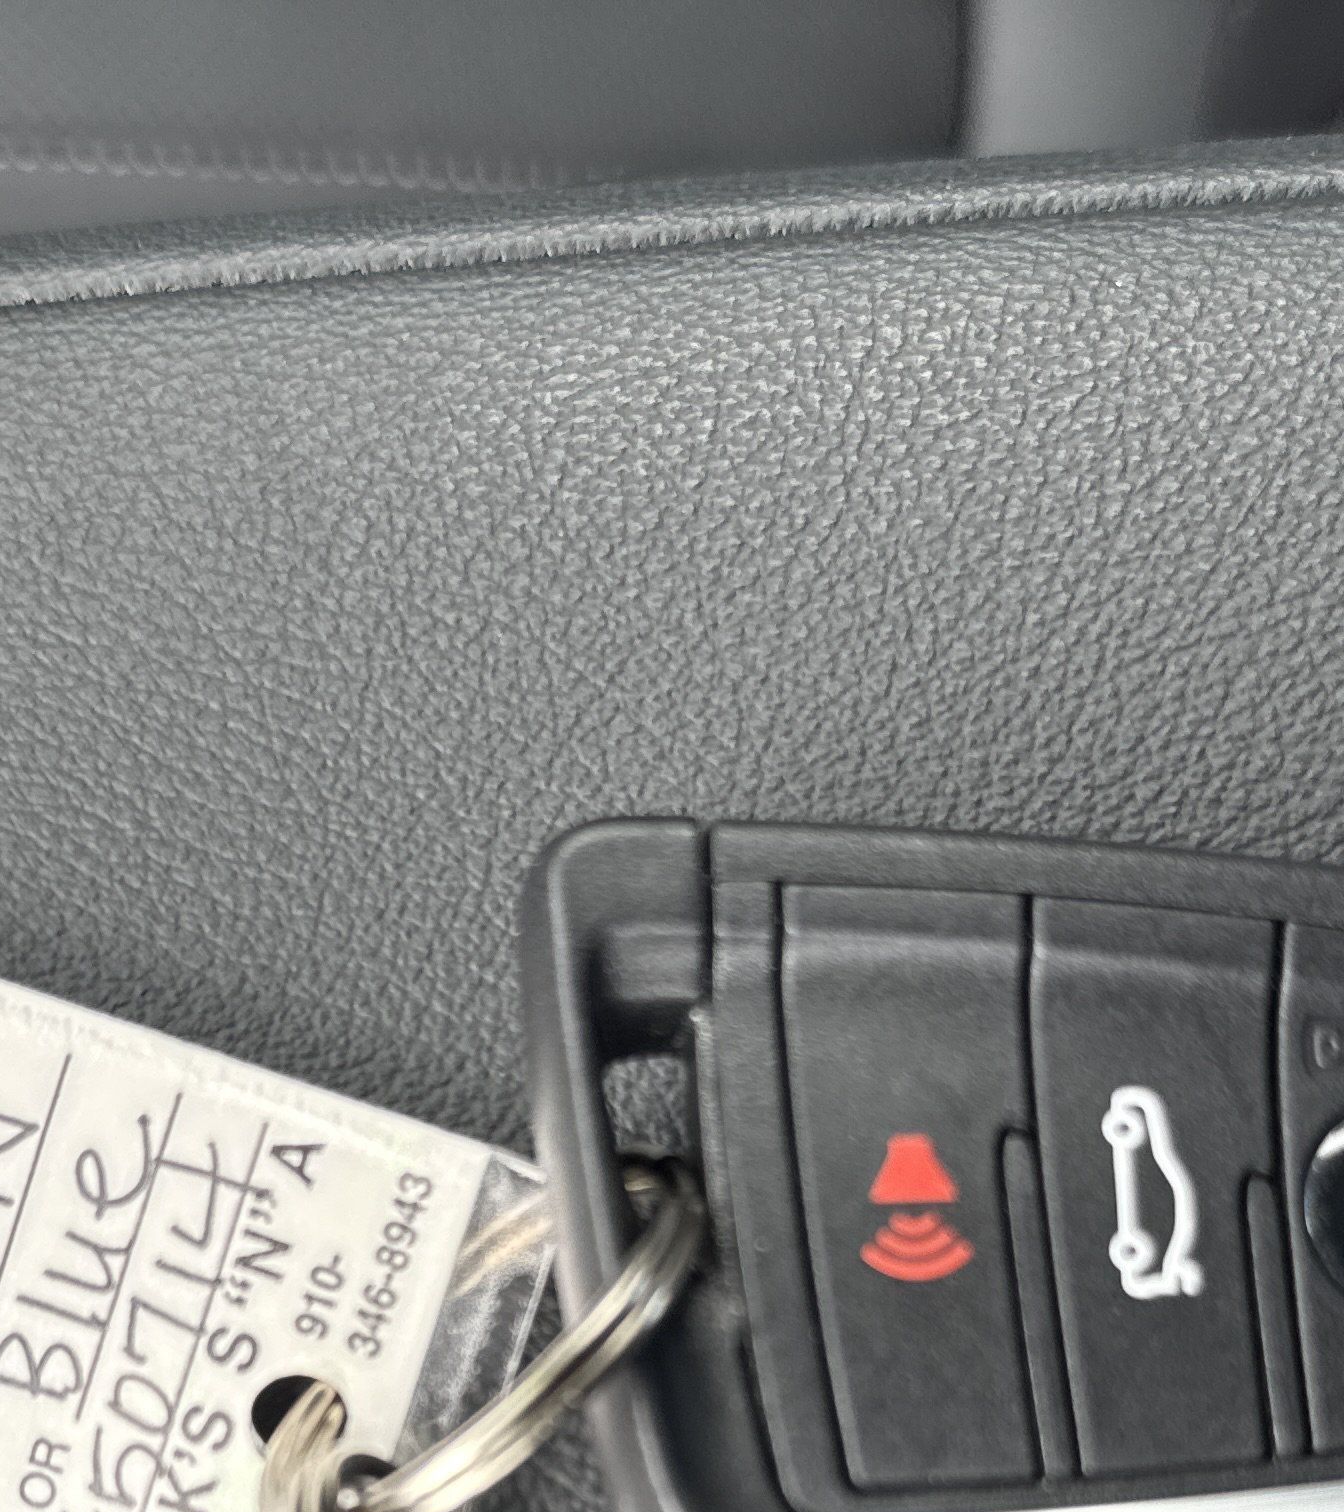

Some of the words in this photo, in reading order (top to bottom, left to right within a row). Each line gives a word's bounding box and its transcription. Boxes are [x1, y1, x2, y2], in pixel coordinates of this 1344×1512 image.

[207, 1325, 258, 1374] S
[270, 1141, 325, 1188] A
[294, 1252, 346, 1341] 910-
[347, 1171, 434, 1359] 346-8943
